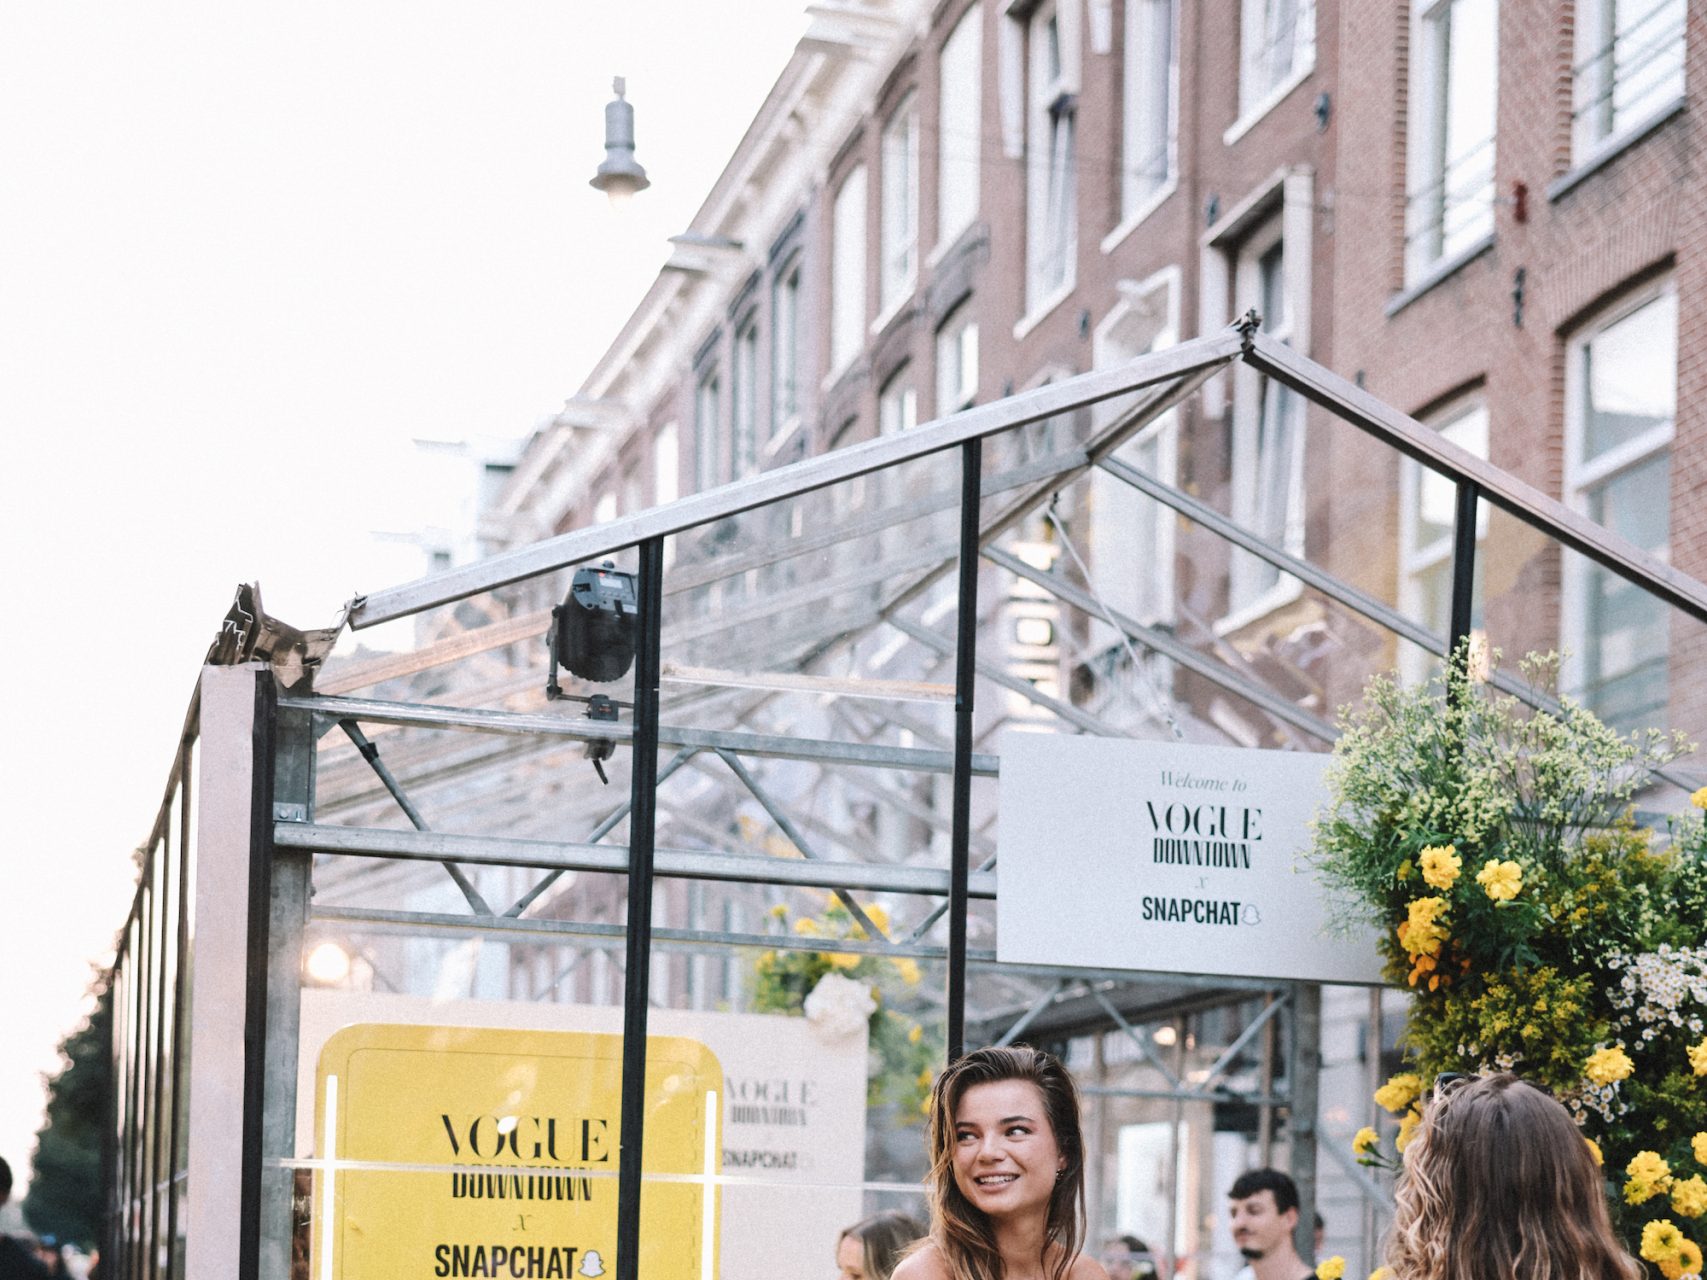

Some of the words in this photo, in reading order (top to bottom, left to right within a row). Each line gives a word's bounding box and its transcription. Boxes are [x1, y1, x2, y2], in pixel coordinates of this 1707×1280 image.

[1160, 770, 1229, 792] Welcome
[1231, 779, 1247, 792] to
[1146, 800, 1262, 841] VOGUE
[1153, 837, 1251, 869] DOWNTOWN
[1142, 896, 1241, 926] SNAPCHAT
[441, 1114, 609, 1163] VOGUE
[451, 1163, 593, 1201] DOWNTOWN
[434, 1244, 578, 1279] SNAPCHAT
